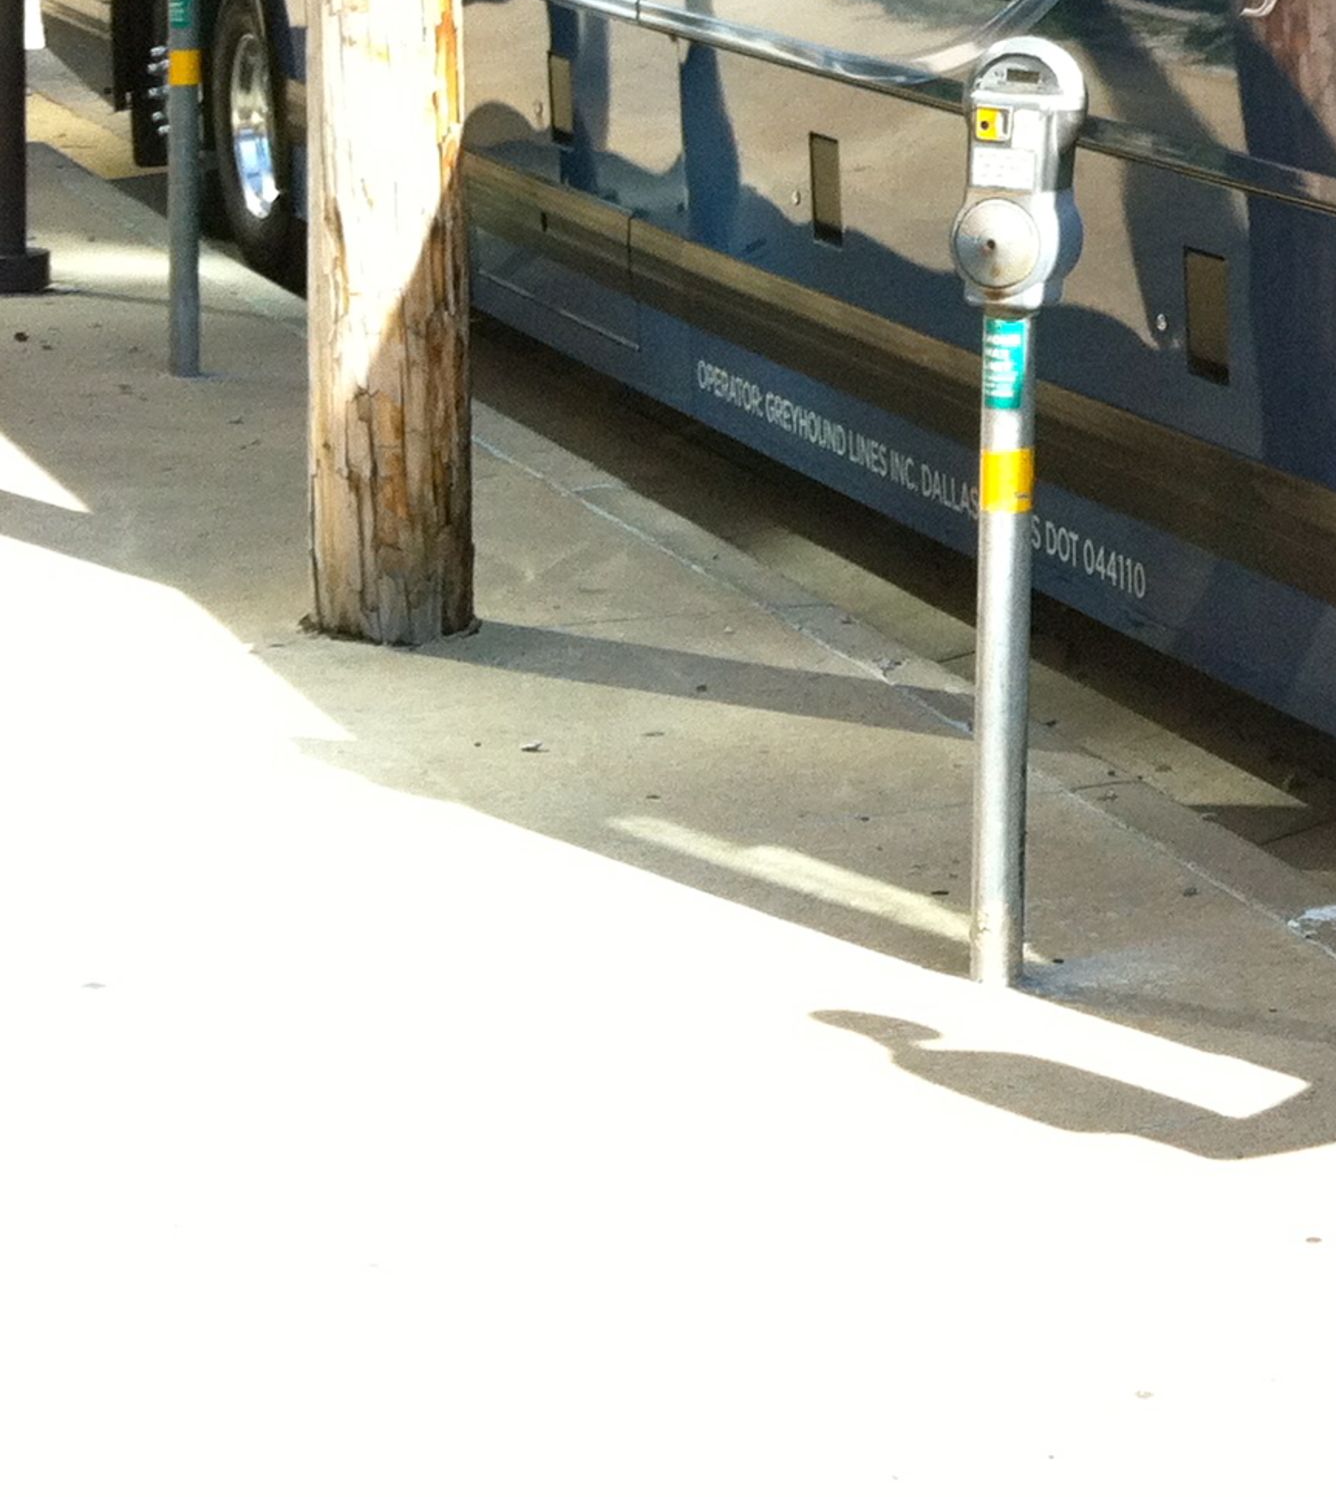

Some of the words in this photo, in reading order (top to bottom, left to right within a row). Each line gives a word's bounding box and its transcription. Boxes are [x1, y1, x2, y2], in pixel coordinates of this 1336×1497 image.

[765, 391, 846, 455] GREYHOUND
[849, 430, 887, 477] LINES
[1045, 520, 1079, 567] DOT
[1083, 539, 1146, 599] 044110
